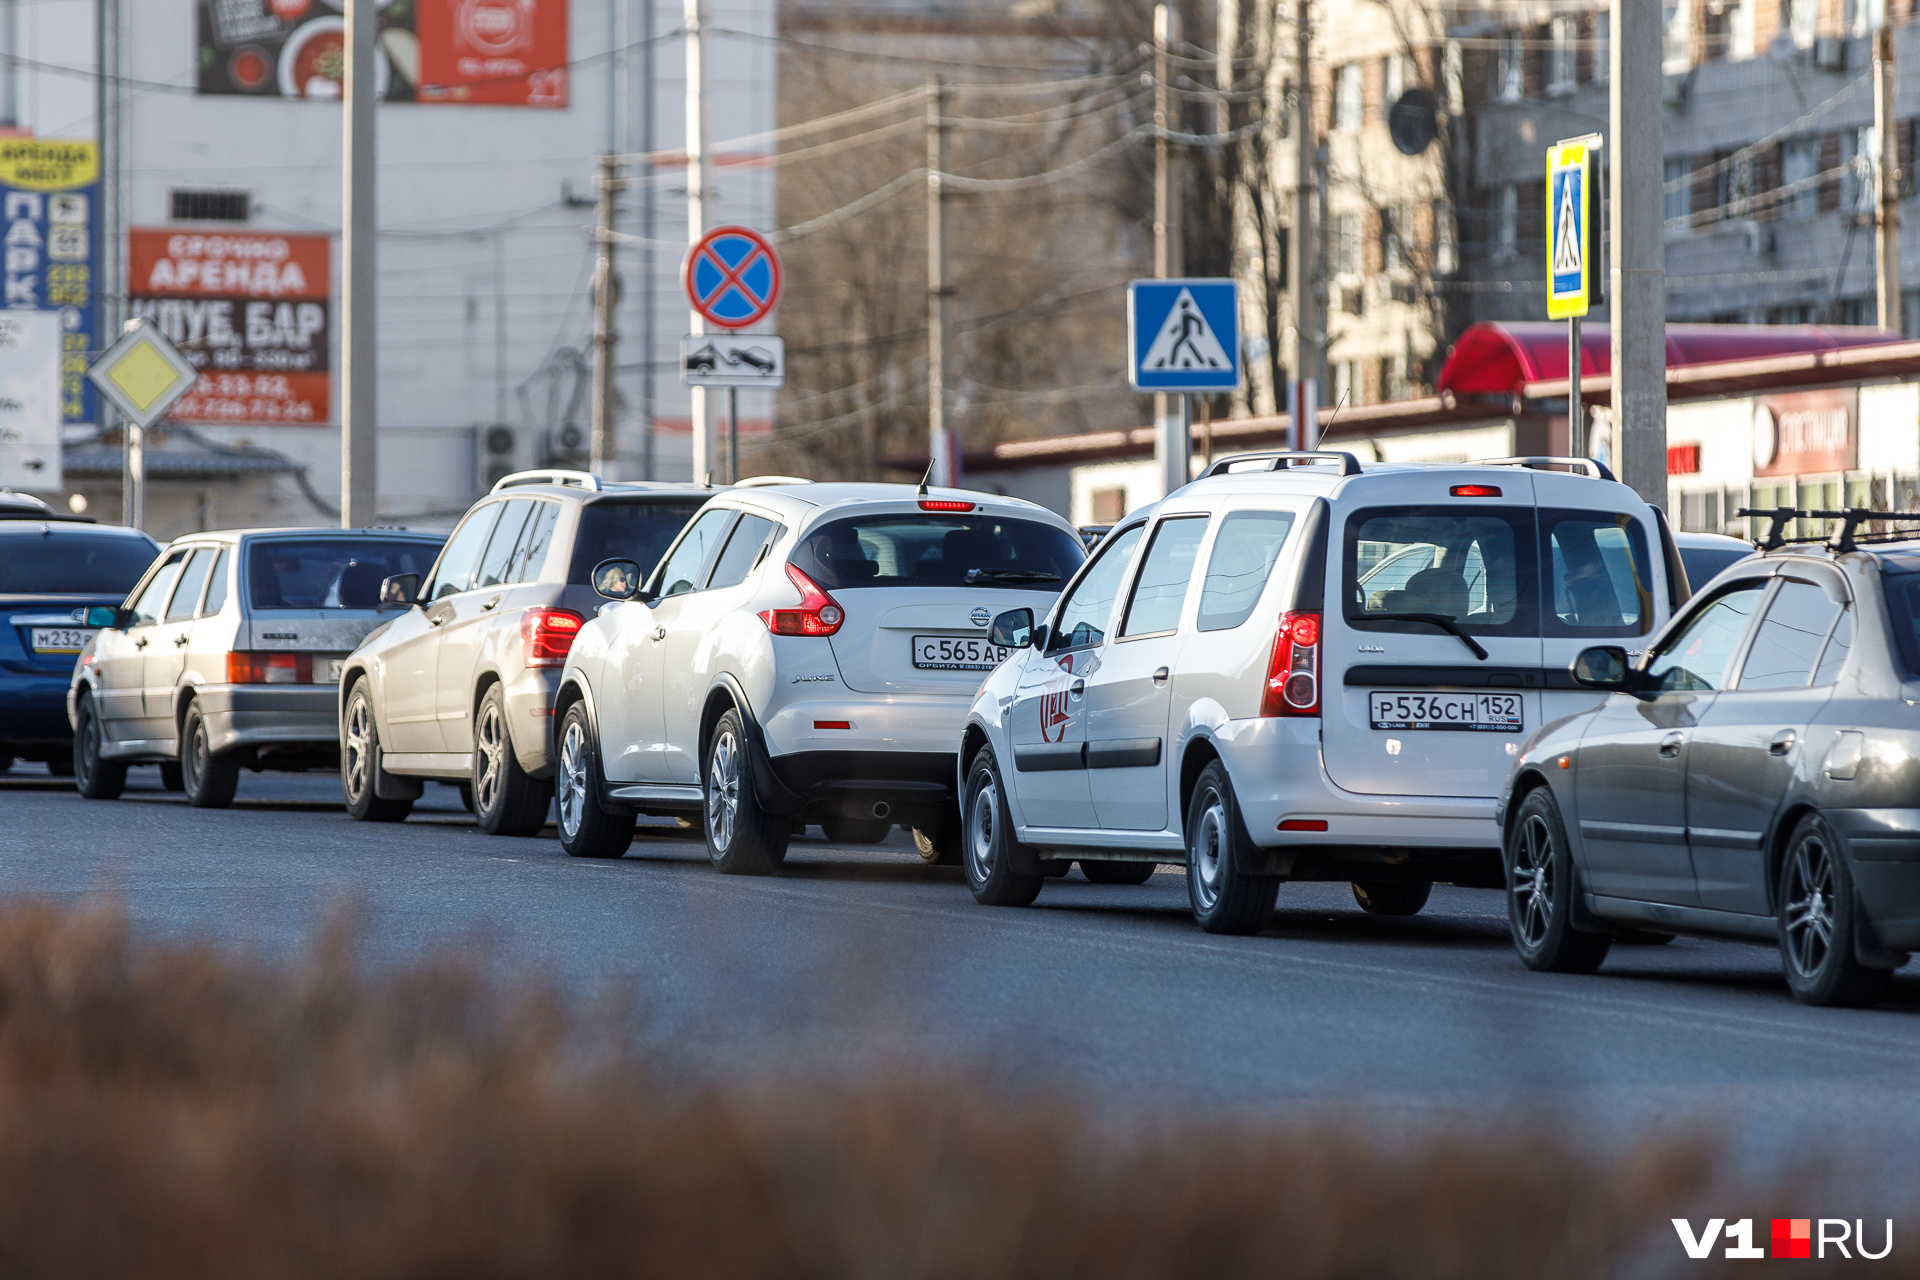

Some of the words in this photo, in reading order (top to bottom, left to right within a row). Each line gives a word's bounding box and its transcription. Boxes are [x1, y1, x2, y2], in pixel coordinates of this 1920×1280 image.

[4, 190, 44, 308] ПАРК
[168, 234, 290, 262] СРОЧНО
[149, 258, 308, 296] АРЕНДА
[245, 301, 325, 350] БАР
[1358, 644, 1384, 653] LADA
[791, 674, 835, 684] JUKE
[1380, 696, 1475, 721] Р536СН
[1480, 696, 1516, 715] 152
[1488, 715, 1507, 723] RUS
